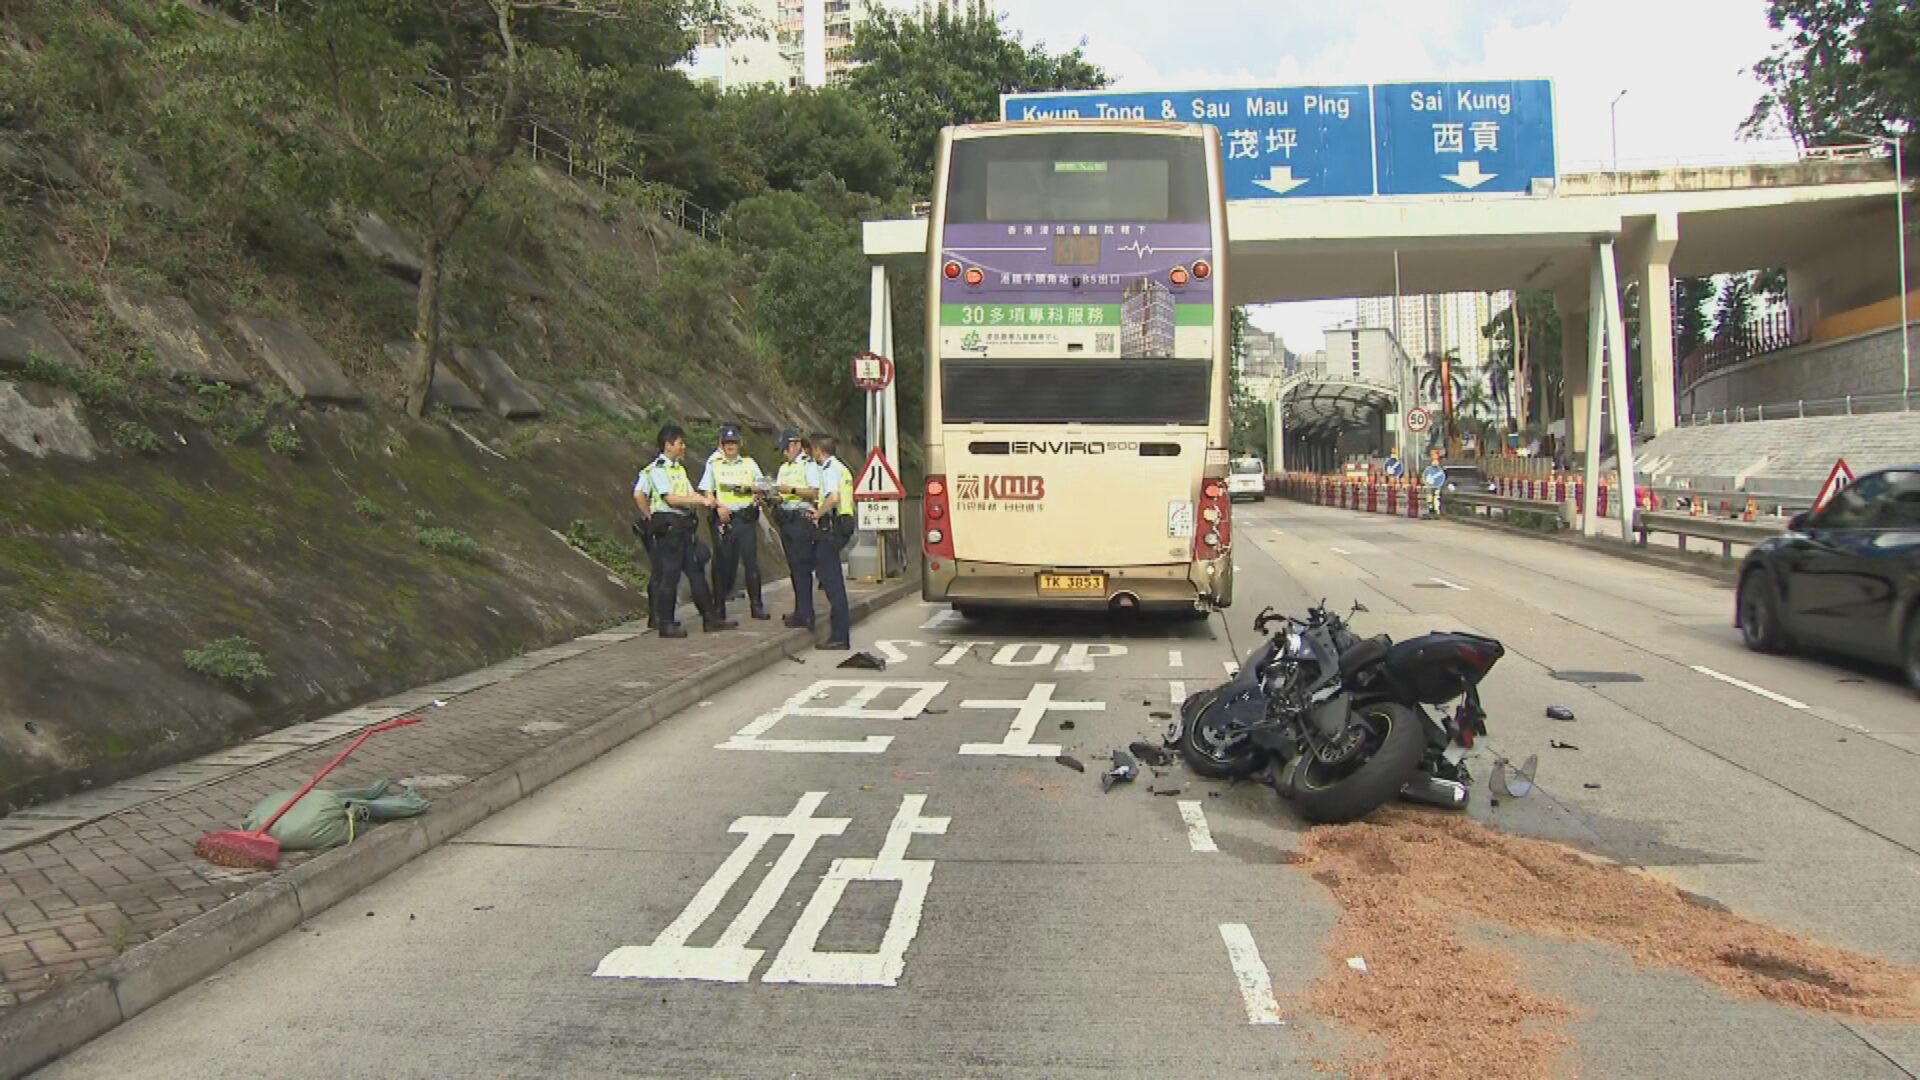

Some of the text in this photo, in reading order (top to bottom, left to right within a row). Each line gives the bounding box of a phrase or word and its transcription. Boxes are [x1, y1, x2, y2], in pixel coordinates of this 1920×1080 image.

[1023, 94, 1350, 120] Kwun Tong & Sau Mau Ping
[1410, 89, 1511, 114] Sai Kung
[1220, 127, 1298, 159] 茂坪
[1431, 120, 1501, 153] 西貢
[1410, 414, 1424, 425] 50
[983, 475, 1045, 501] KMB
[1044, 576, 1101, 588] TK 3853
[874, 640, 1128, 671] STOP
[713, 680, 1106, 757] 巴士
[592, 792, 951, 986] 站
